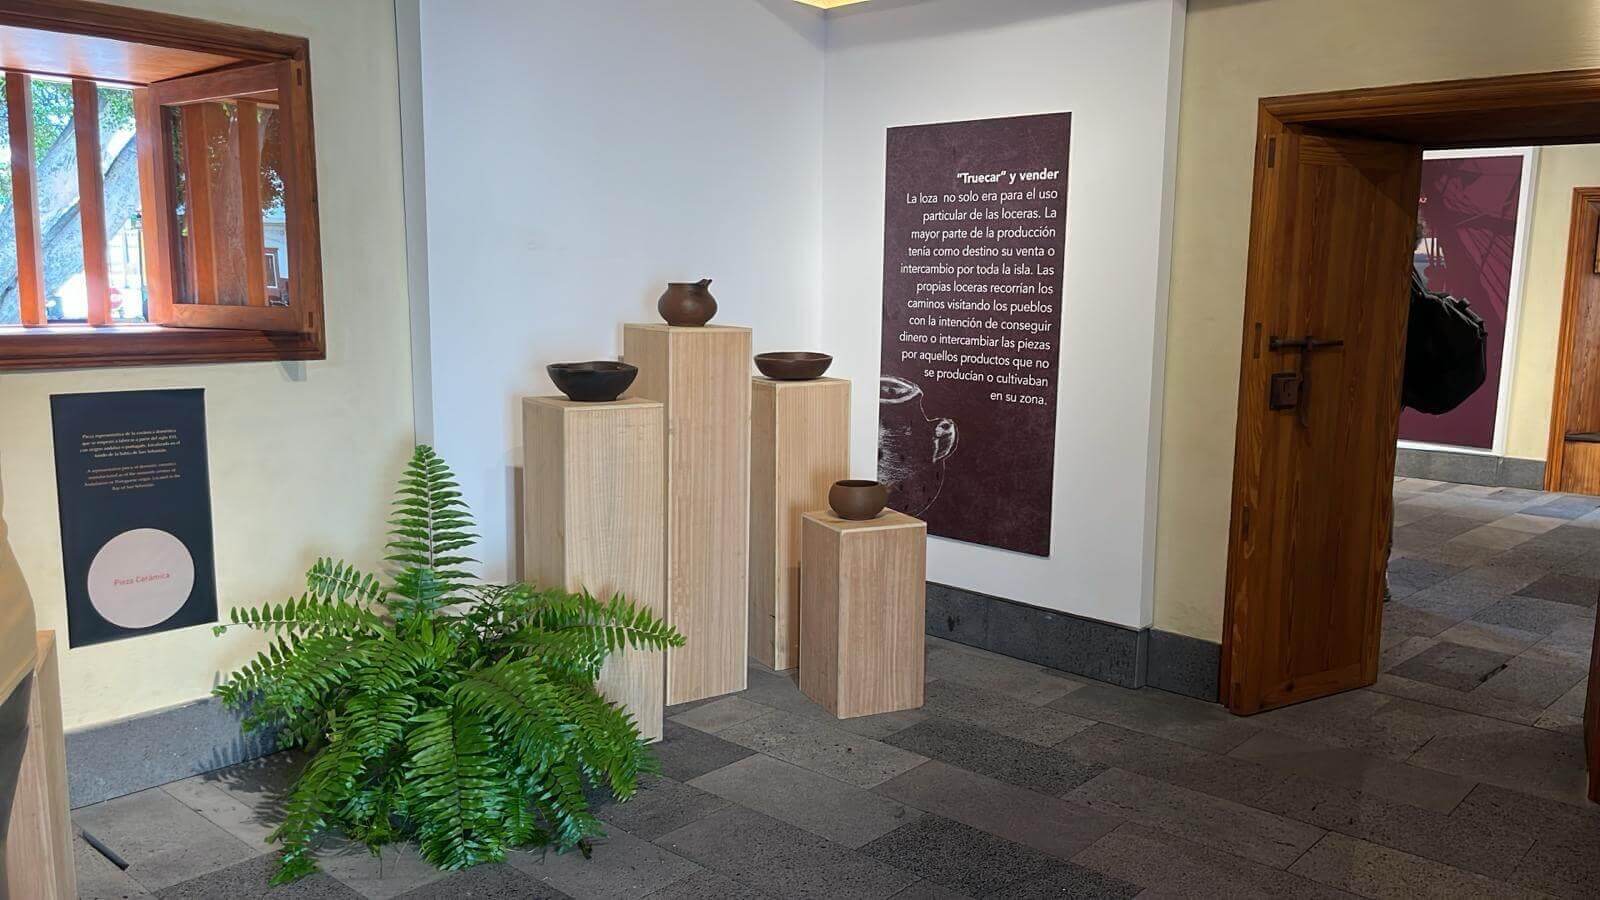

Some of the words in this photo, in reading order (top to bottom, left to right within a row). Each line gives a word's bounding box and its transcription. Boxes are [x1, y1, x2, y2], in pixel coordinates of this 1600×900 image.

[1009, 173, 1017, 185] y
[1019, 168, 1059, 181] vender
[906, 193, 917, 204] La
[919, 192, 938, 204] loza
[943, 194, 956, 203] no
[958, 190, 979, 202] solo
[981, 192, 997, 201] era
[1000, 192, 1023, 204] para
[1026, 188, 1036, 200] el
[1039, 190, 1058, 199] uso
[923, 209, 967, 225] particular
[969, 208, 983, 220] de
[985, 208, 999, 220] las
[1001, 207, 1041, 219] loceras.
[1044, 207, 1057, 218] La
[911, 230, 940, 242] mayor
[942, 228, 968, 242] parte
[969, 226, 983, 238] de
[986, 226, 995, 238] la
[997, 225, 1056, 241] producción
[908, 245, 931, 256] tenía
[933, 248, 960, 256] como
[962, 245, 999, 256] destino
[1001, 248, 1013, 256] su
[1015, 246, 1045, 257] venta
[1047, 248, 1055, 256] o
[900, 263, 955, 274] intercambio
[956, 266, 975, 278] por
[976, 263, 999, 275] toda
[1002, 263, 1011, 275] la
[1014, 263, 1033, 275] isla.
[1037, 264, 1055, 275] Las
[916, 281, 951, 295] propias
[953, 281, 988, 293] loceras
[990, 282, 1035, 294] recorrían
[1038, 282, 1054, 294] los
[907, 298, 945, 309] caminos
[947, 298, 991, 311] visitando
[993, 299, 1008, 311] los
[1010, 300, 1053, 315] pueblos
[909, 317, 926, 325] con
[928, 315, 936, 326] la
[938, 316, 982, 328] intención
[985, 317, 998, 329] de
[1000, 320, 1052, 334] conseguir
[899, 331, 928, 343] dinero
[930, 335, 937, 343] o
[939, 333, 999, 347] intercambiar
[1001, 336, 1015, 348] las
[1017, 338, 1051, 352] piezas
[901, 351, 918, 362] por
[919, 350, 958, 364] aquellos
[960, 353, 1010, 366] productos
[1012, 358, 1033, 370] que
[1035, 360, 1050, 369] no
[924, 369, 935, 378] se
[936, 368, 984, 382] producían
[986, 374, 994, 382] o
[996, 372, 1048, 387] cultivaban
[990, 392, 1003, 401] en
[1005, 394, 1017, 402] su
[1019, 395, 1047, 405] zona.
